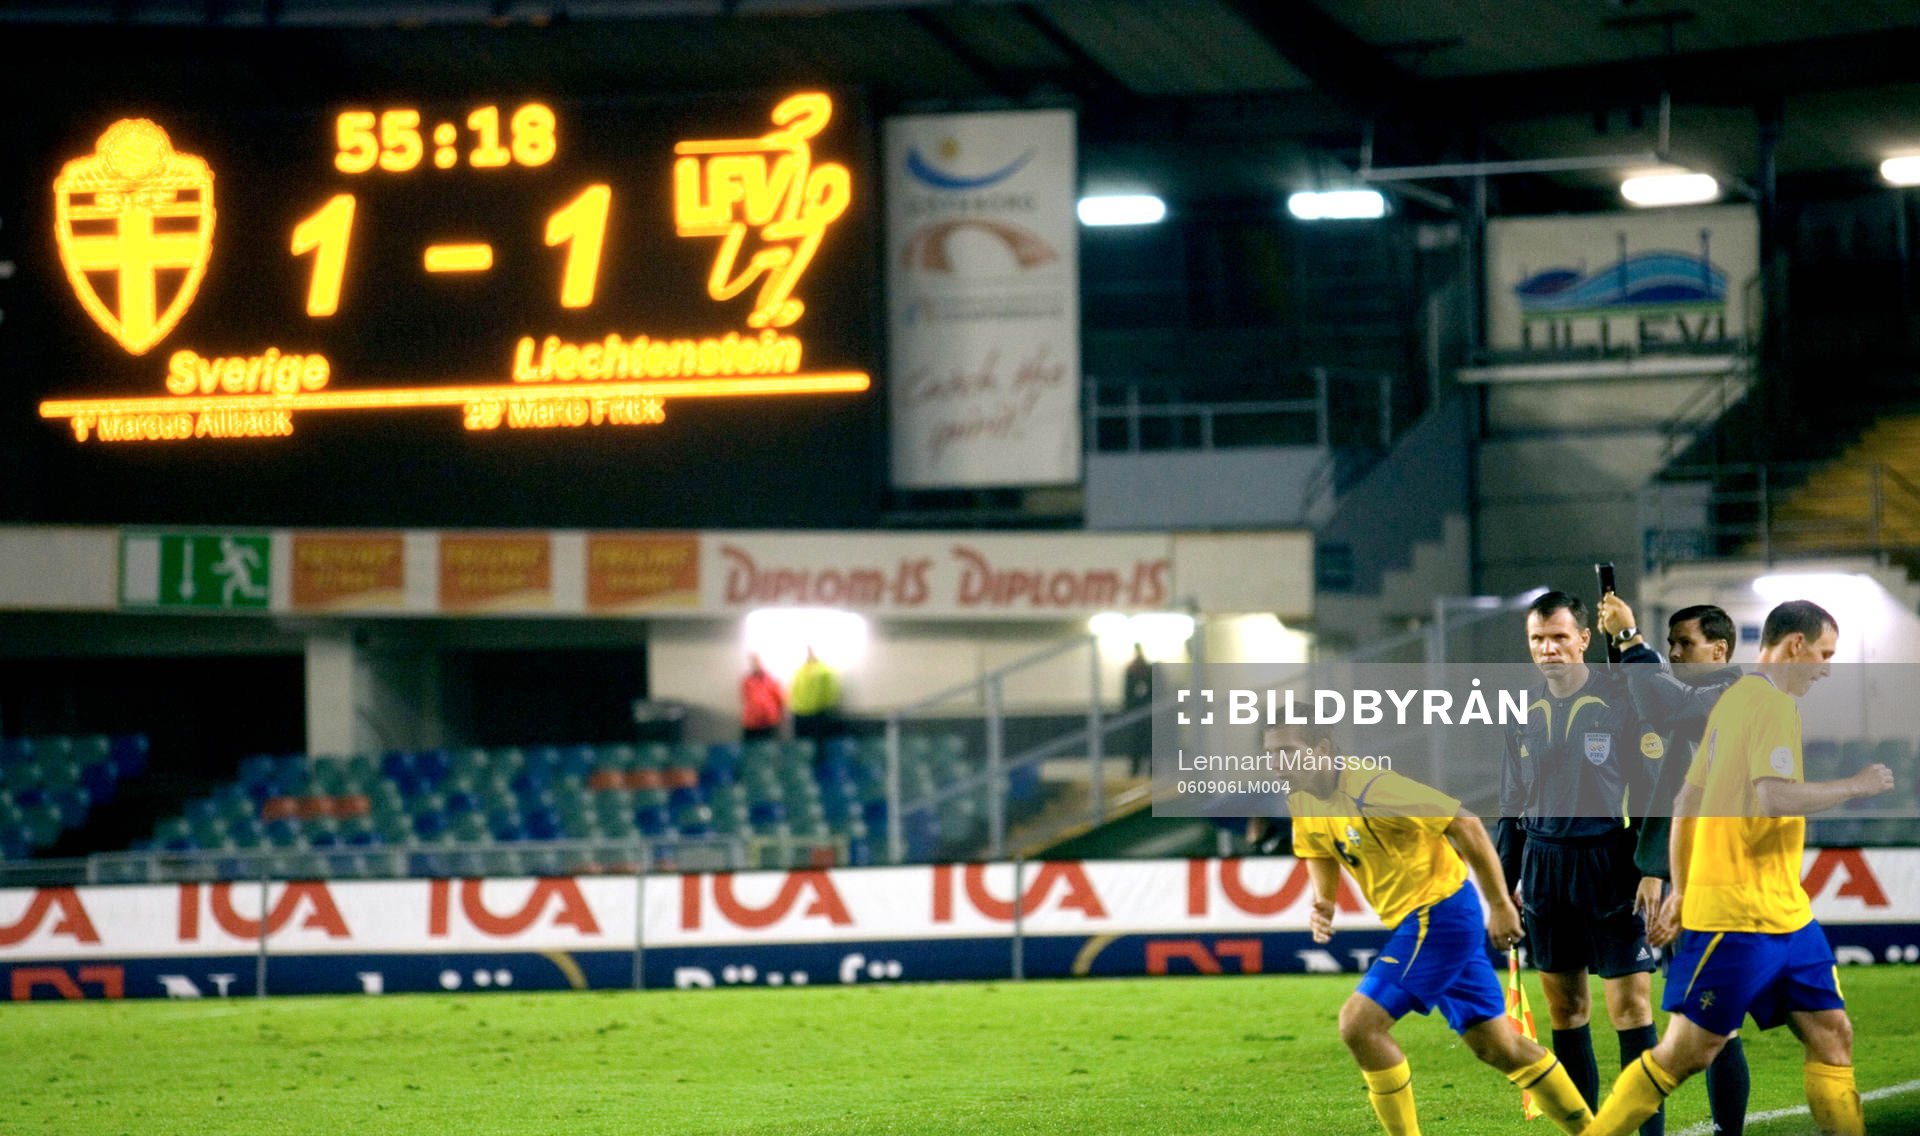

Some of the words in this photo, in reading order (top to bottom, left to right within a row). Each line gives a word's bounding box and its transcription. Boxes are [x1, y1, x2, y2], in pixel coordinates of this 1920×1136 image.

[335, 104, 557, 173] 55:18
[291, 194, 356, 317] 1
[545, 184, 612, 308] 1
[166, 347, 331, 400] Sverige
[512, 329, 802, 383] Liechtenstein
[178, 881, 353, 941] ICA
[428, 878, 603, 938] ICA
[680, 867, 854, 931] ICA
[931, 861, 1110, 924] ICA
